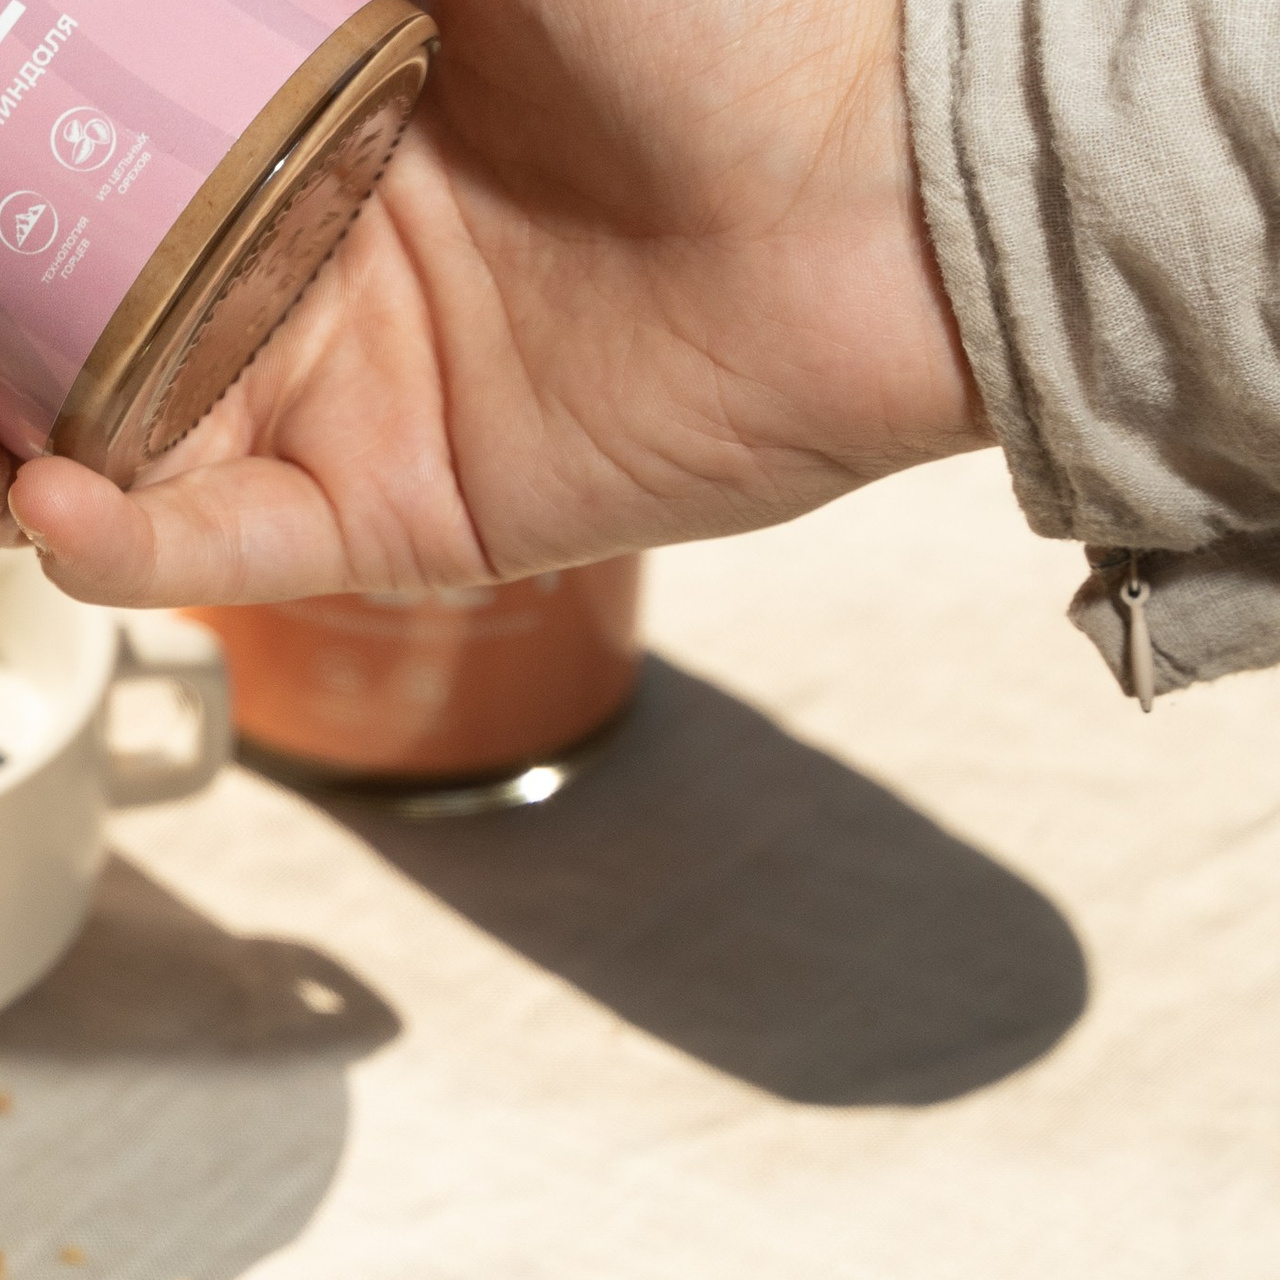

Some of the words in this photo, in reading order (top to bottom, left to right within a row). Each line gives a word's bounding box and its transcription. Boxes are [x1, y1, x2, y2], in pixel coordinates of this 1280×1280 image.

[117, 151, 151, 195] ОРЕХОВ
[40, 216, 89, 284] ТЕХНОЛОГИЯ
[61, 239, 90, 279] ГОРЦЕВ
